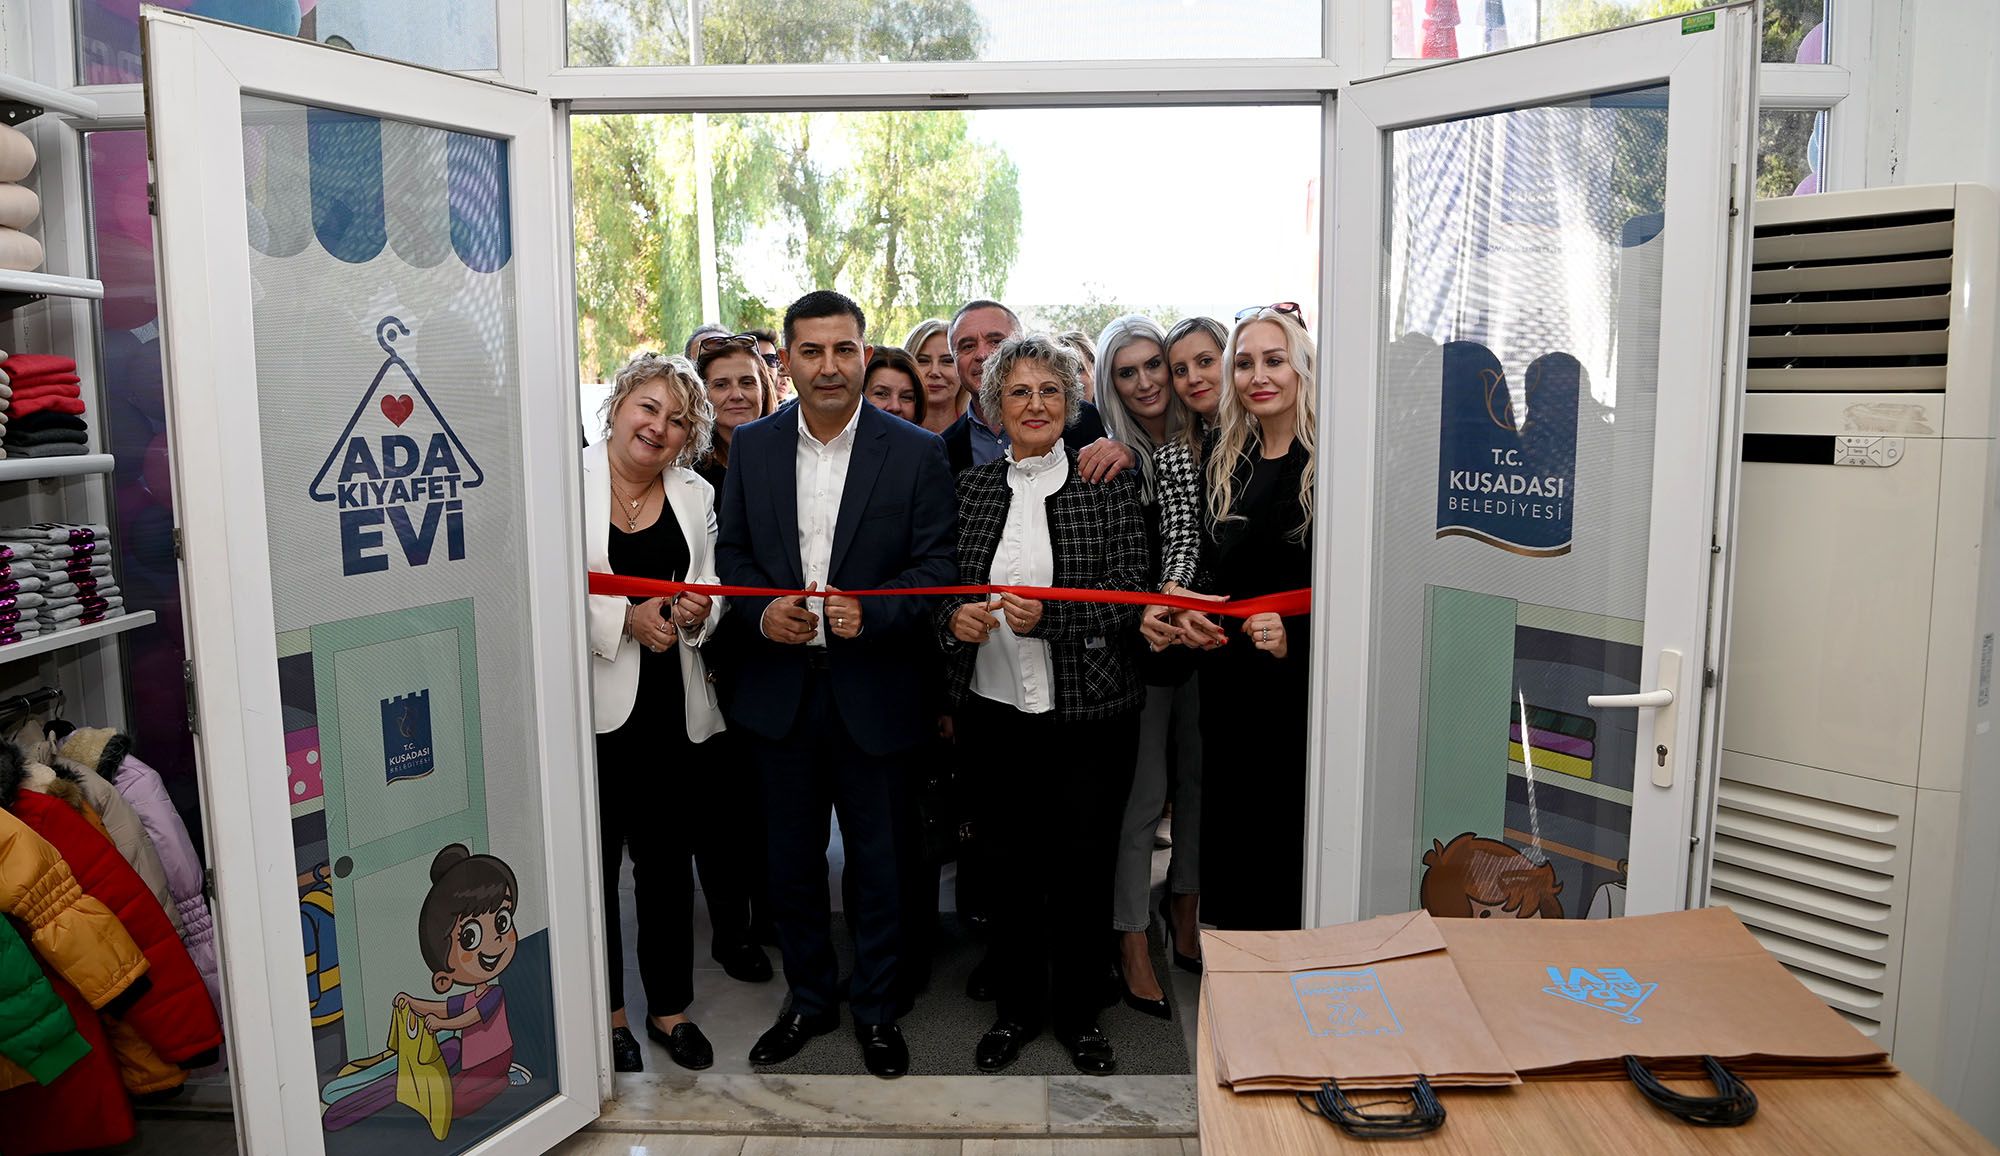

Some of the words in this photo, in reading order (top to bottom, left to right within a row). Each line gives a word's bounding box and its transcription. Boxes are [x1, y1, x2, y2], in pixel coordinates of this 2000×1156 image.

[338, 433, 460, 482] ADA
[1491, 449, 1523, 466] T.C.
[338, 474, 461, 509] KIYAFET
[1450, 470, 1564, 498] KUŞADASI
[1449, 496, 1562, 520] BELEDİYESİ
[339, 499, 465, 577] EVİ
